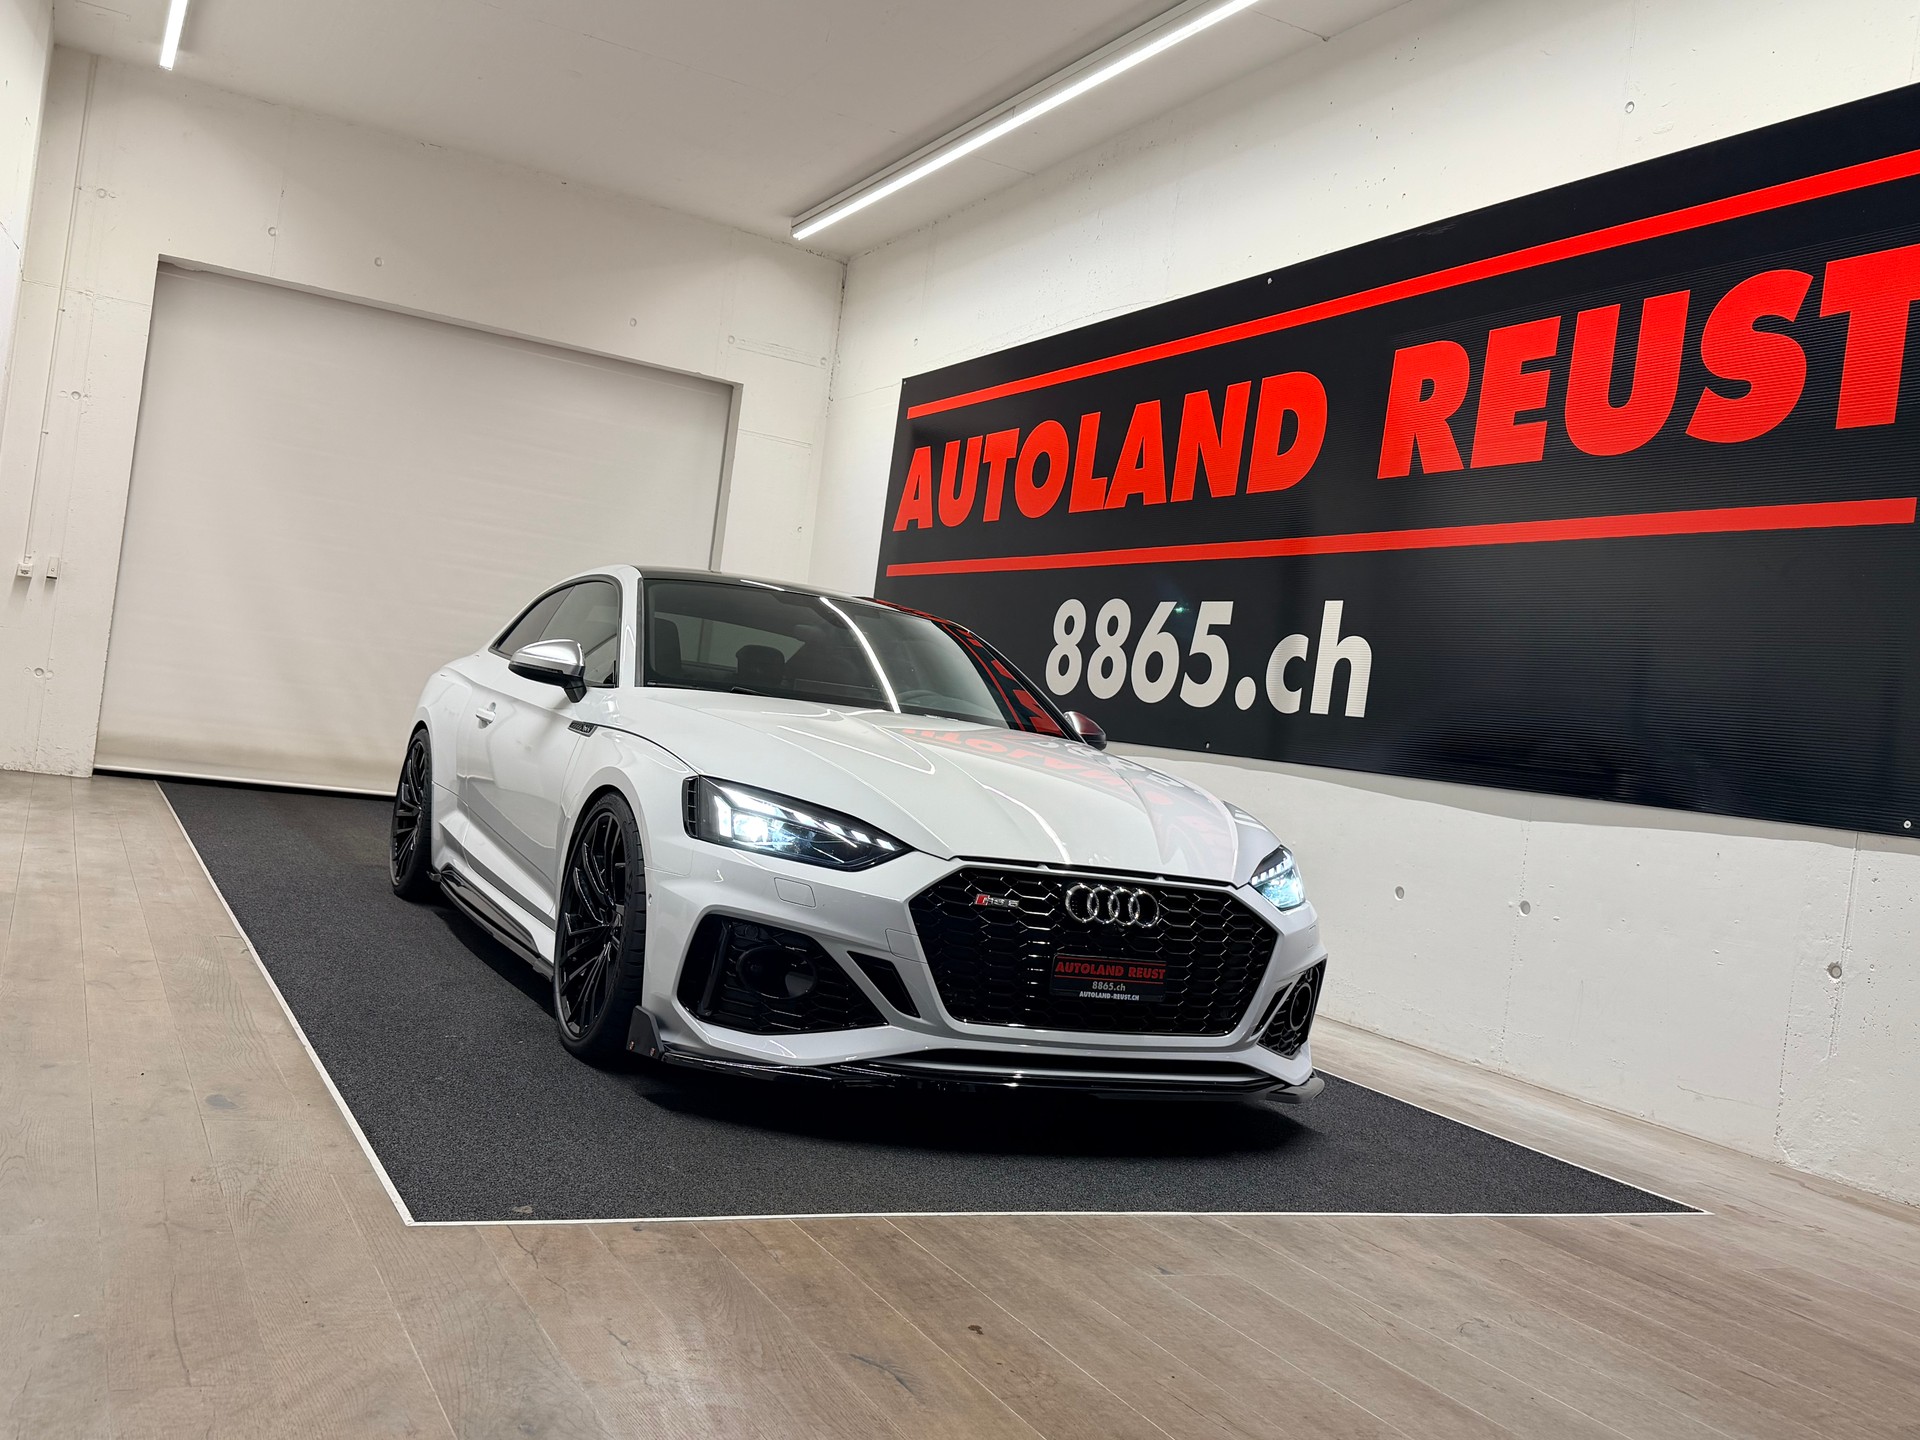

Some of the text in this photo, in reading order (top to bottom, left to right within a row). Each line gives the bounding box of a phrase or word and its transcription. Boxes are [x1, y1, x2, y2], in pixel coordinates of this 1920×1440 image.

[892, 243, 1920, 533] AUTOLAND REUST
[1045, 598, 1373, 719] 8865.ch
[1055, 962, 1165, 979] AUTOLAND REUST
[1092, 981, 1126, 992] 8865.ch
[1079, 991, 1140, 1001] AUTOLAND-REUST.CH
